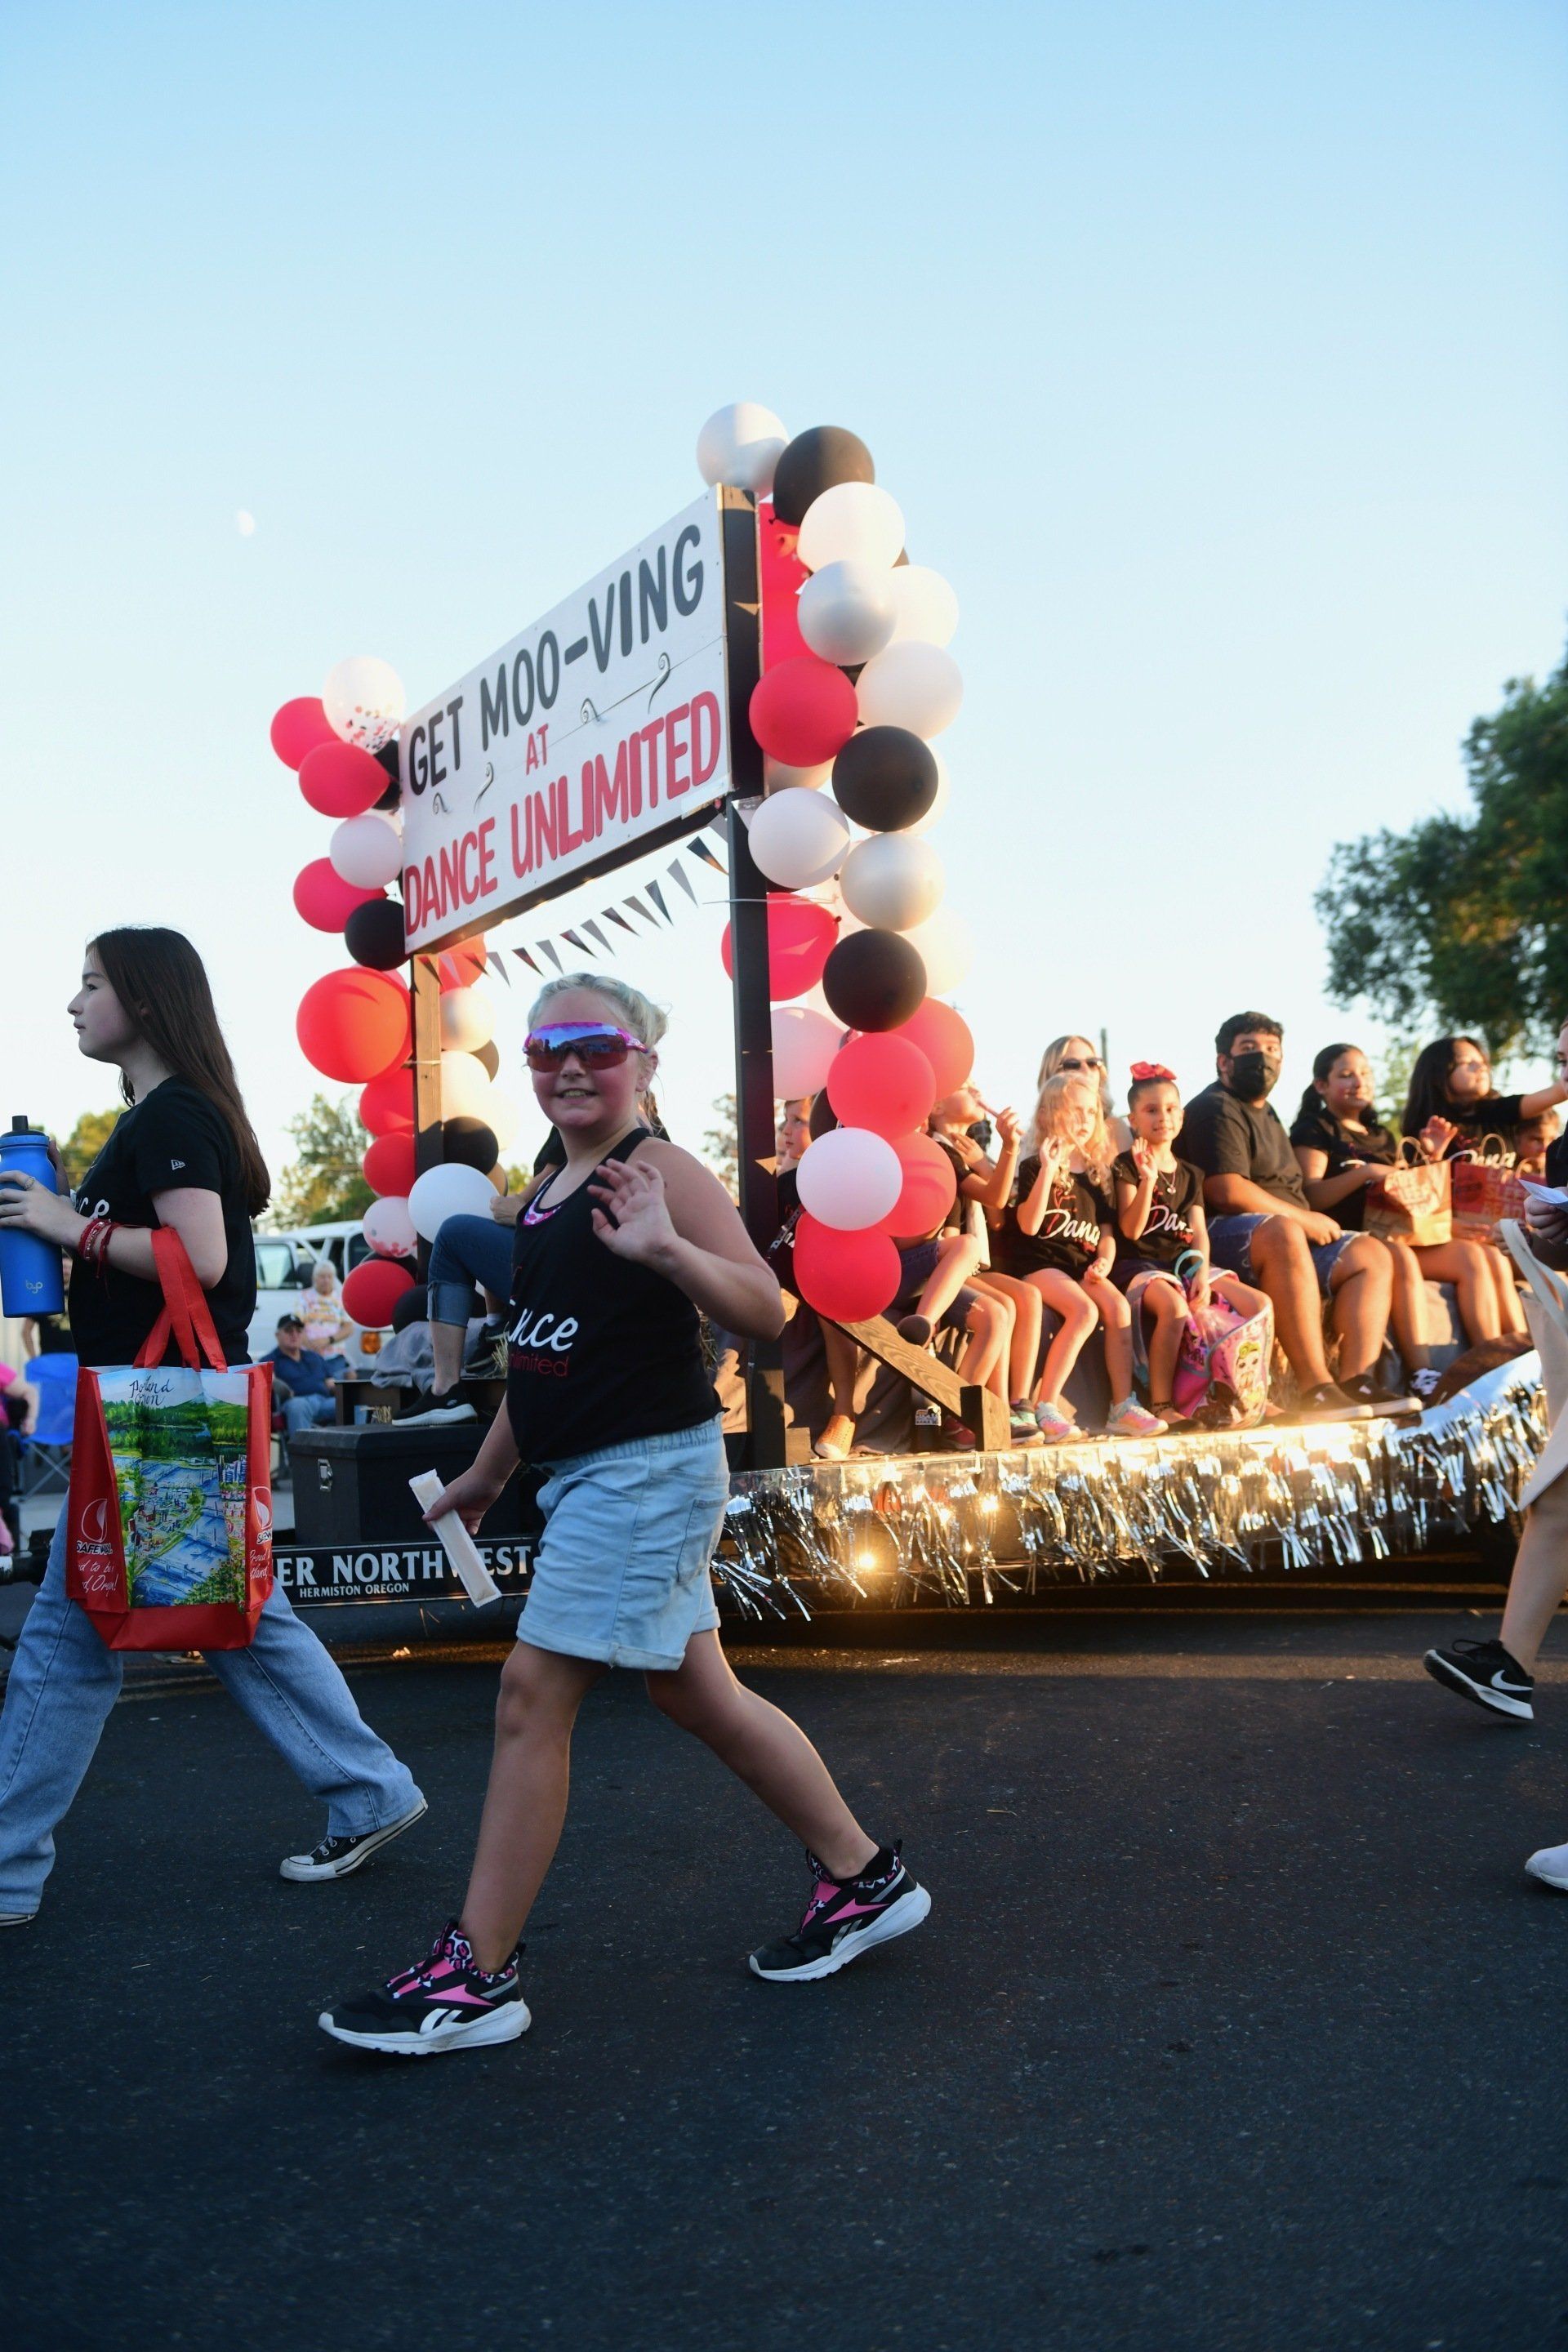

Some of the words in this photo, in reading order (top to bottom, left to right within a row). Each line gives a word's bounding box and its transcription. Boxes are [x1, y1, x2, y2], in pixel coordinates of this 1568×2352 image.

[408, 695, 463, 796] GET
[479, 523, 704, 751] MOO-VING
[524, 723, 550, 776] AT
[405, 816, 498, 936] DANCE
[510, 690, 721, 879] UNLIMITED
[299, 1584, 361, 1598] HERMISTON
[365, 1582, 409, 1595] OREGON
[332, 1545, 531, 1584] NORTHEST
